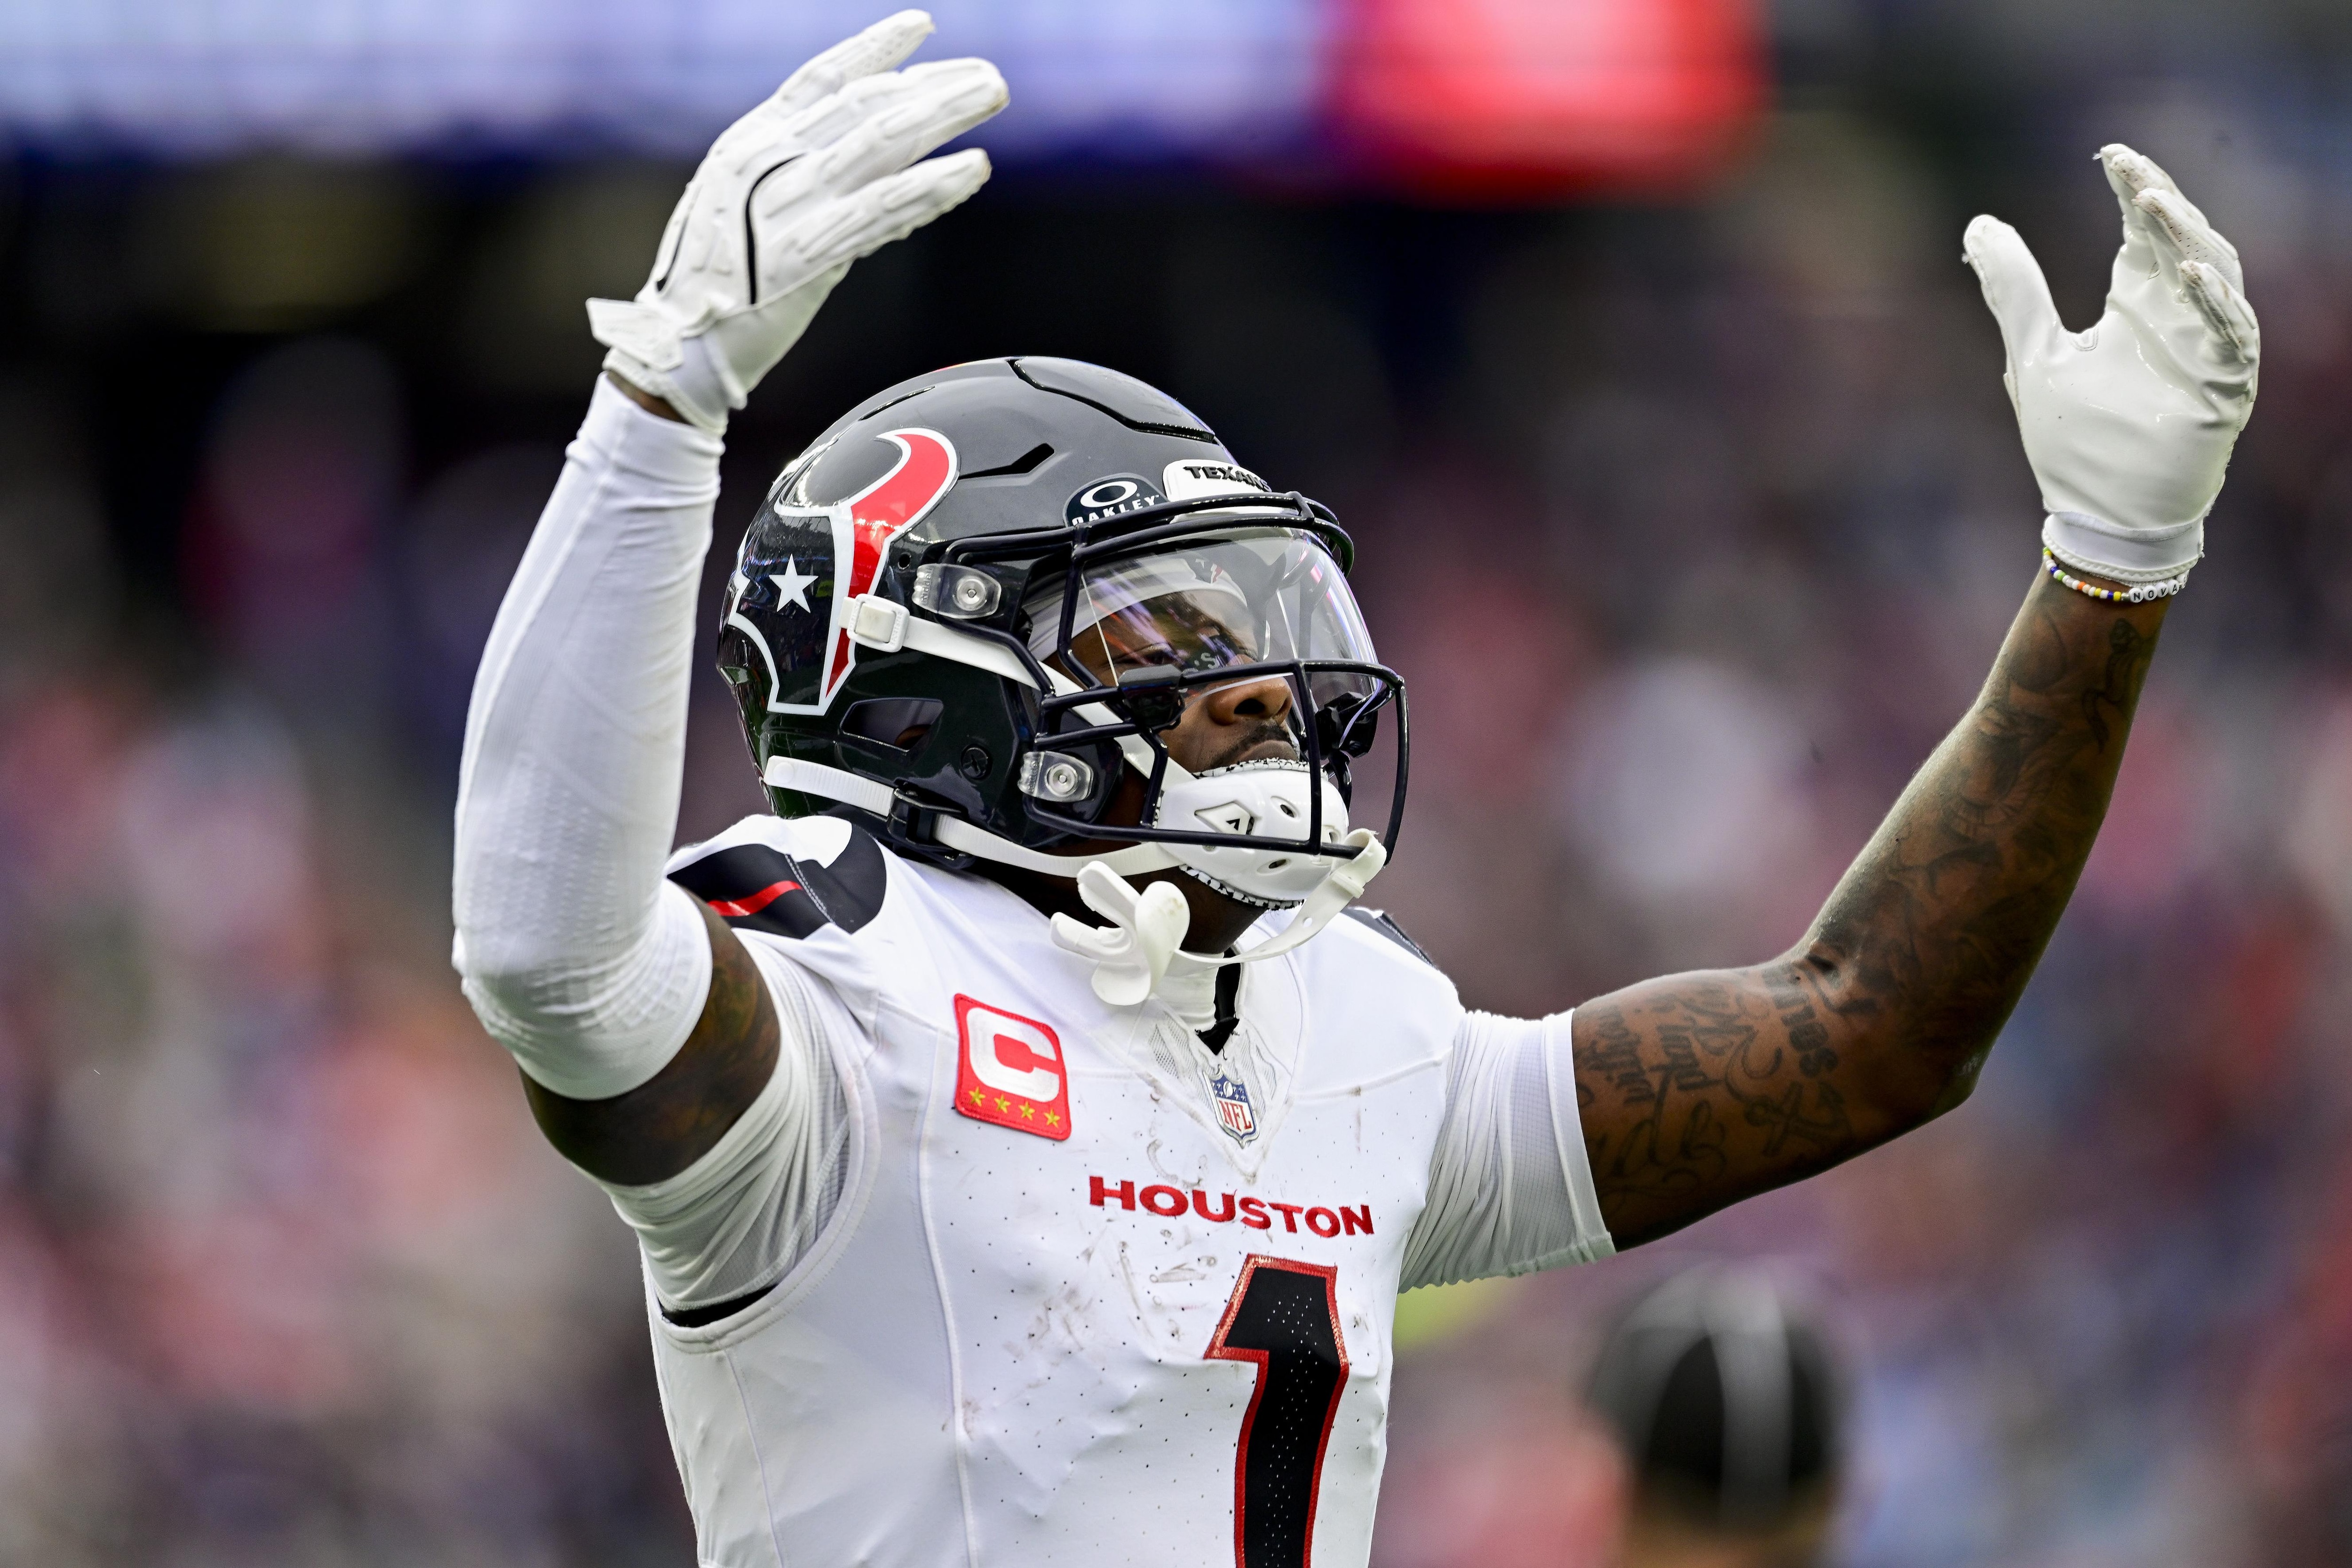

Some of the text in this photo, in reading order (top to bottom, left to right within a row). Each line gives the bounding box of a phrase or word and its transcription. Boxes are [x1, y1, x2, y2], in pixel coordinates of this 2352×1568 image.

[1183, 466, 1272, 493] TEXANS
[1072, 495, 1158, 526] OAKLEY
[2133, 584, 2178, 601] NOVA
[966, 1007, 1060, 1102] C
[1219, 1100, 1253, 1132] NFL
[1089, 1176, 1375, 1238] HOUSTON
[1203, 1253, 1350, 1568] 1
